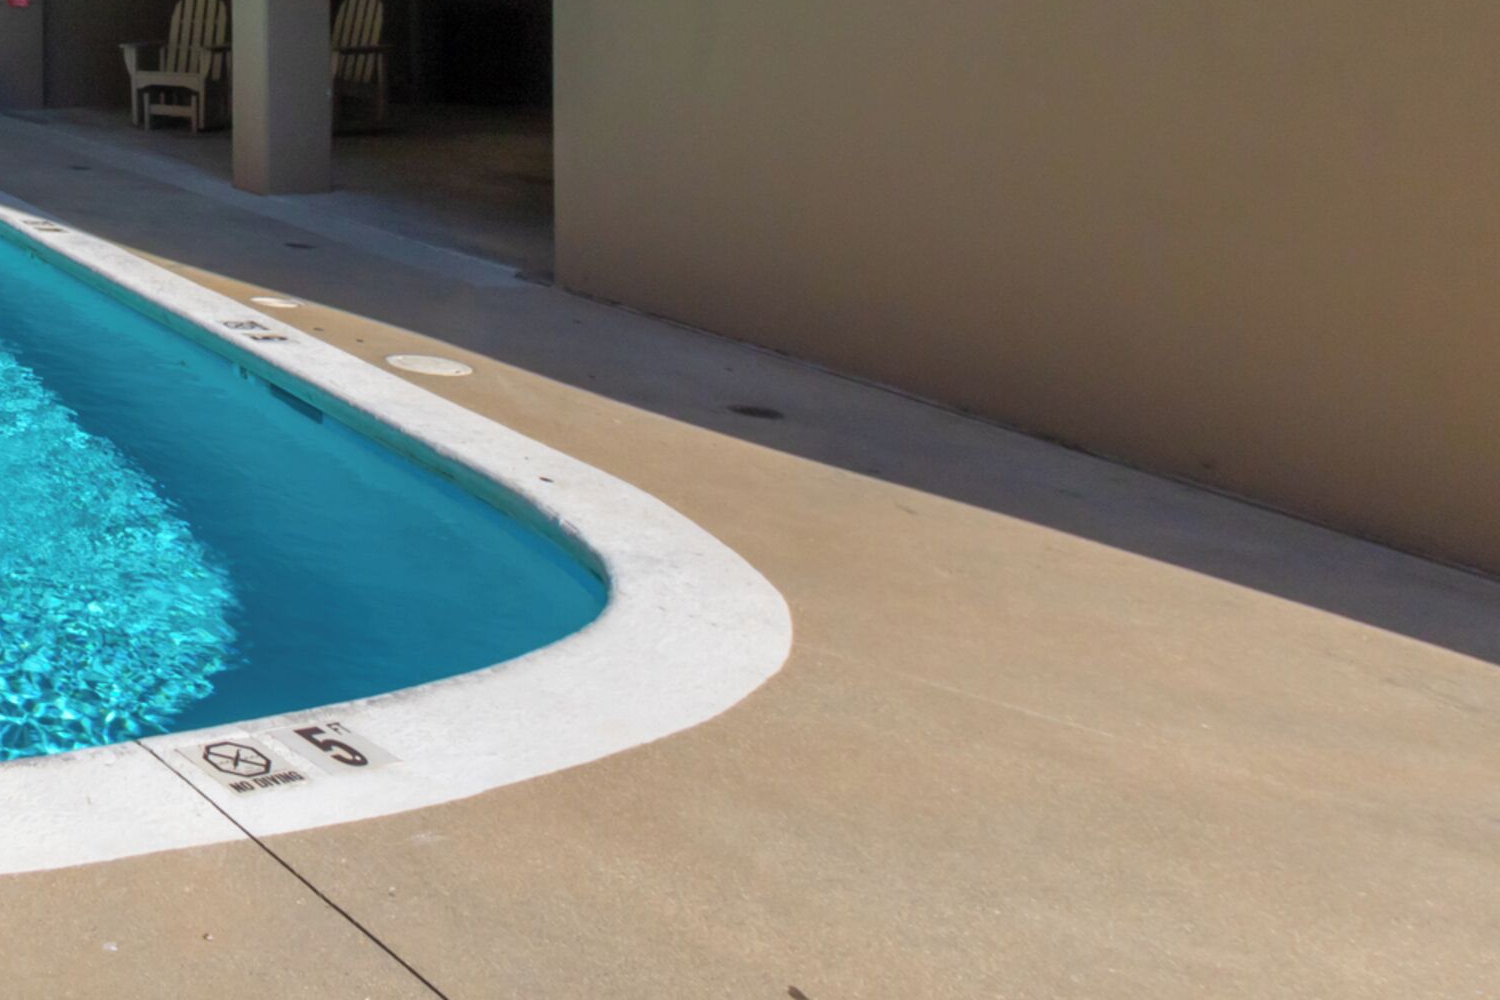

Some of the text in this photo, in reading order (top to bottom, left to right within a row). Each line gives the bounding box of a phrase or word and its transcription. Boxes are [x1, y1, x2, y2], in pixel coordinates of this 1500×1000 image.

[293, 726, 368, 767] 5
[229, 771, 305, 793] NO DIVING
